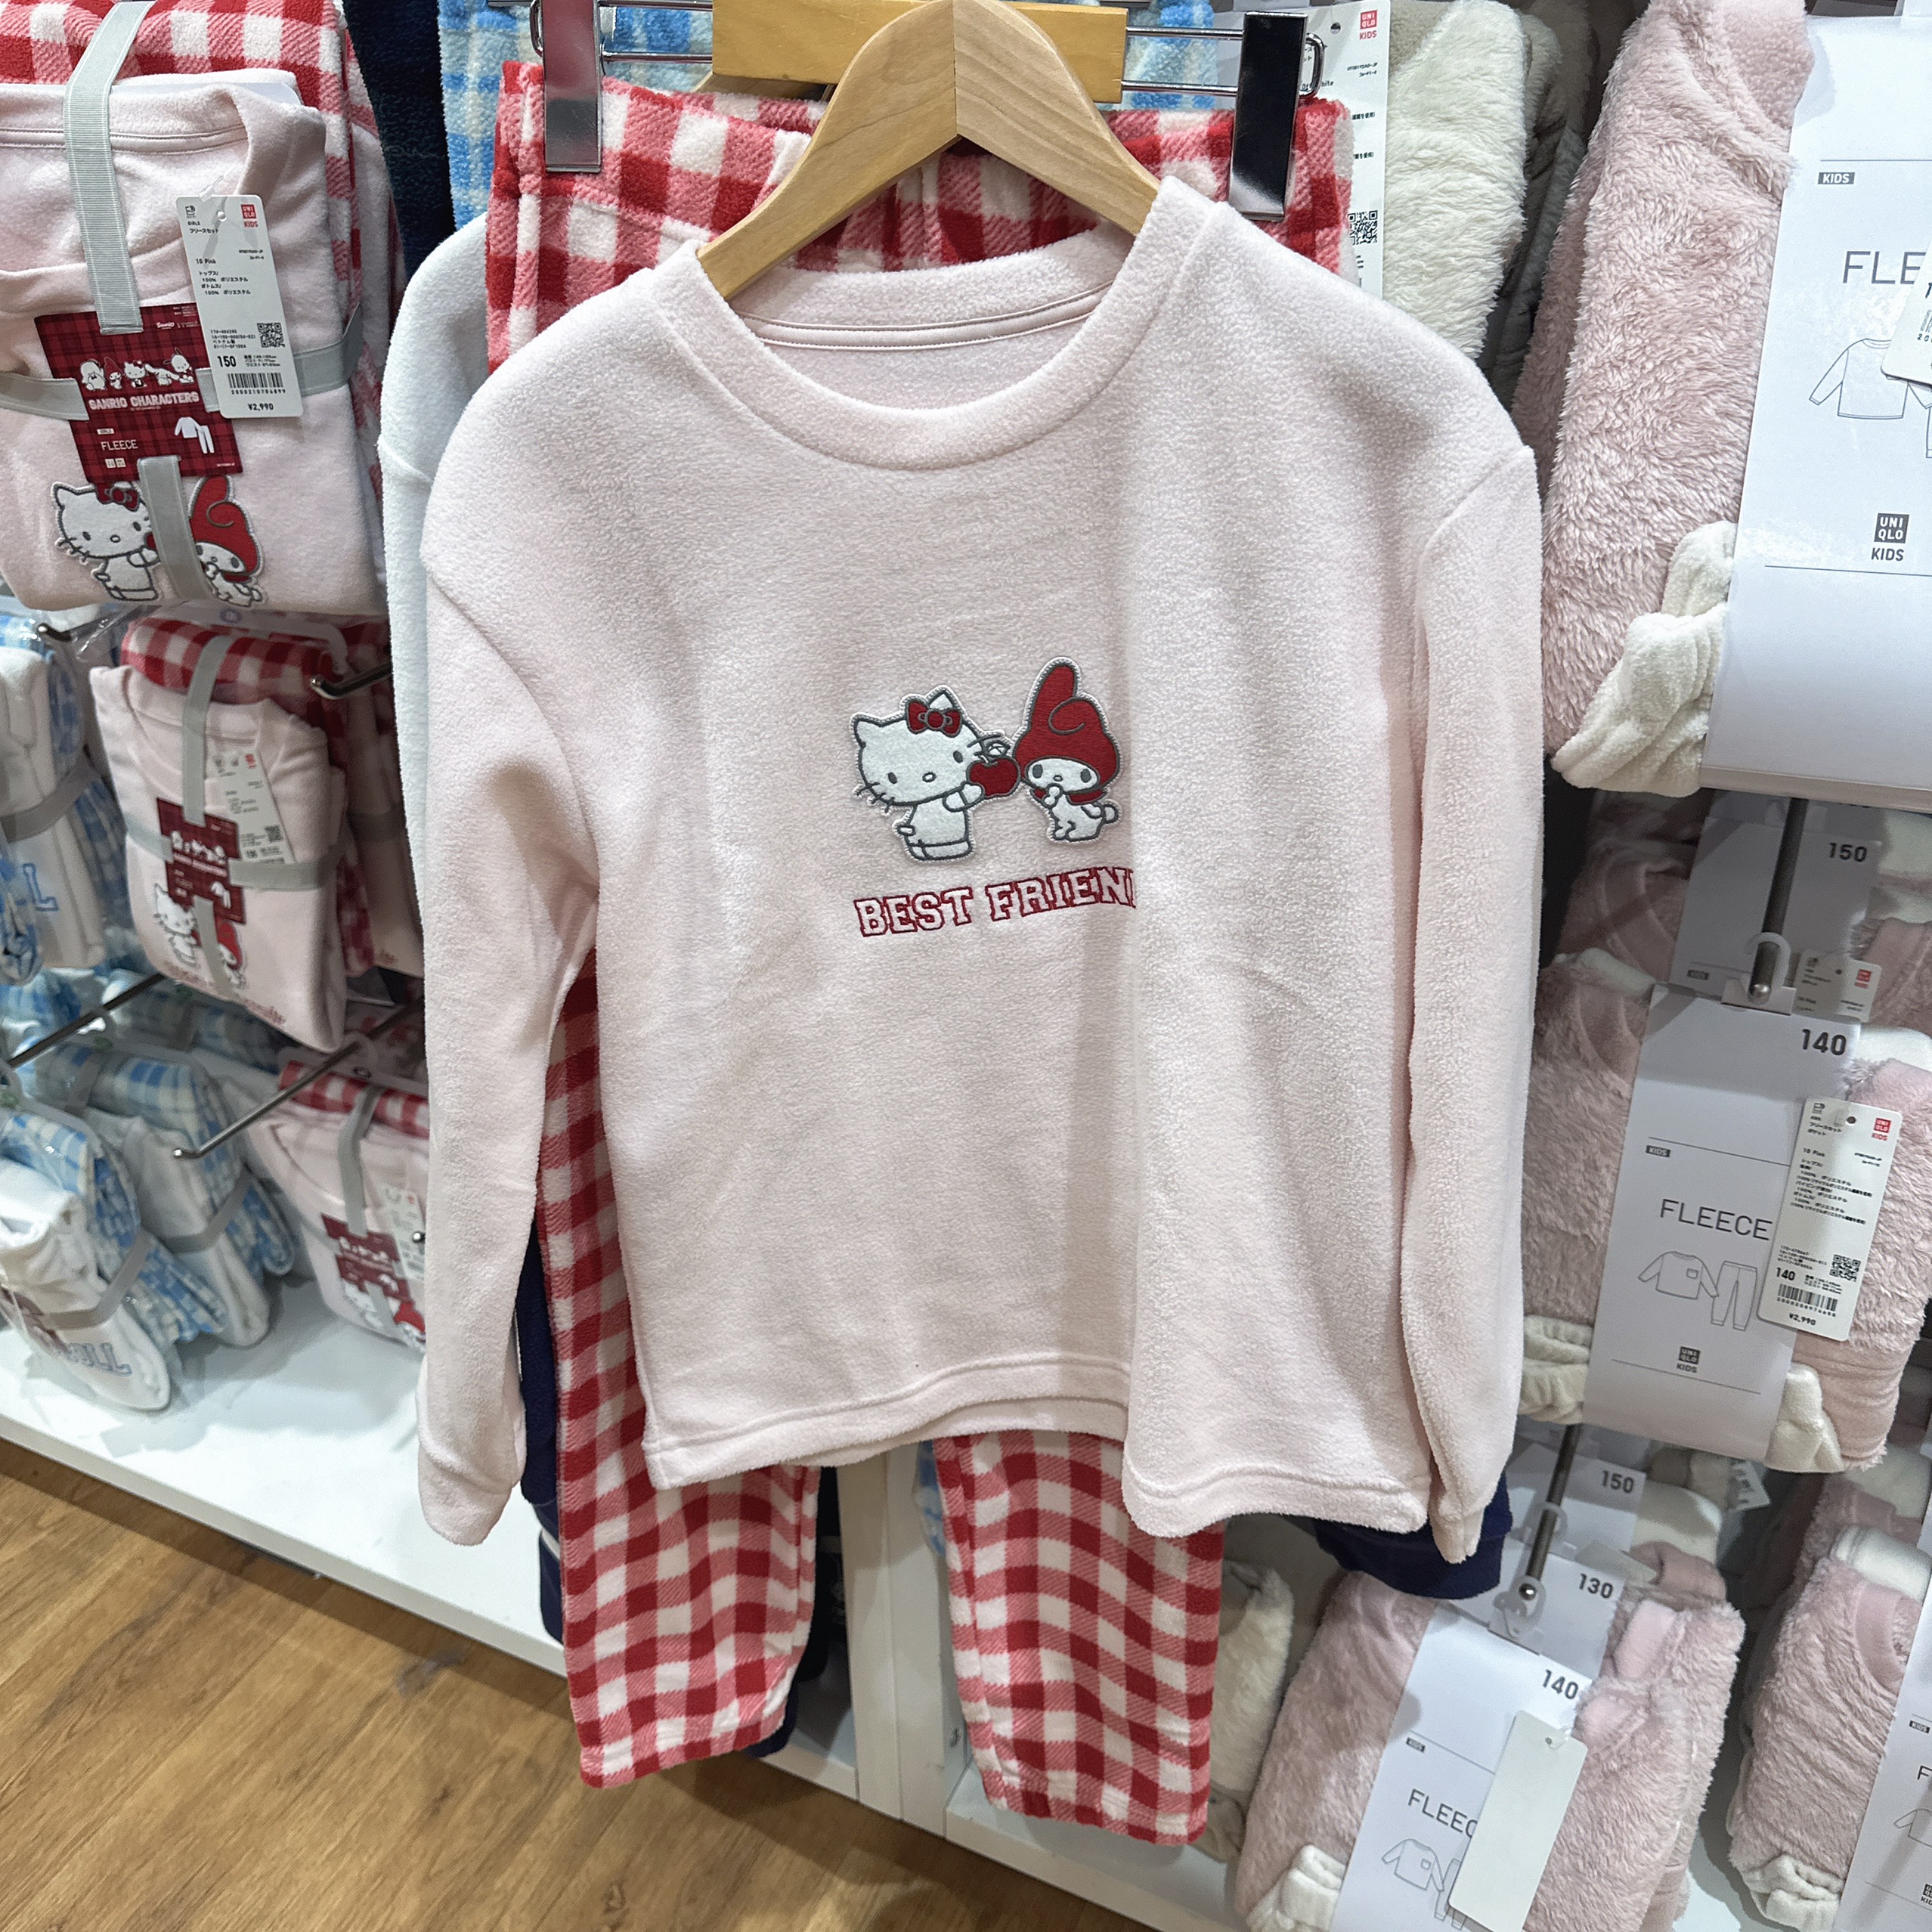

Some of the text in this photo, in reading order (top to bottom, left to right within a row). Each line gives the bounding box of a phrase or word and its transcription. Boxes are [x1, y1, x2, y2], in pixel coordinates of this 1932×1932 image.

[1359, 30, 1377, 40] KIDS
[1823, 173, 1850, 183] KIDS
[1843, 250, 1926, 284] FLE
[217, 356, 236, 367] 150
[88, 391, 199, 410] SANRIO CHARACTERS
[100, 439, 139, 451] FLEECE
[1871, 548, 1905, 562] KIDS
[1828, 842, 1867, 862] 150
[854, 866, 1137, 937] BEST FRIEN
[1802, 1028, 1847, 1055] 140
[1809, 1122, 1842, 1133] フリースセット
[1871, 1132, 1888, 1141] KIDS
[1649, 1147, 1667, 1156] KIDS
[1660, 1199, 1773, 1241] FLEECE
[1776, 1267, 1796, 1281] 140
[1789, 1312, 1816, 1326] ¥2,990
[1676, 1362, 1698, 1373] KIDS
[1602, 1470, 1634, 1493] 150
[1579, 1573, 1614, 1598] 130
[1542, 1669, 1579, 1699] 140
[1407, 1788, 1478, 1839] FLEEC
